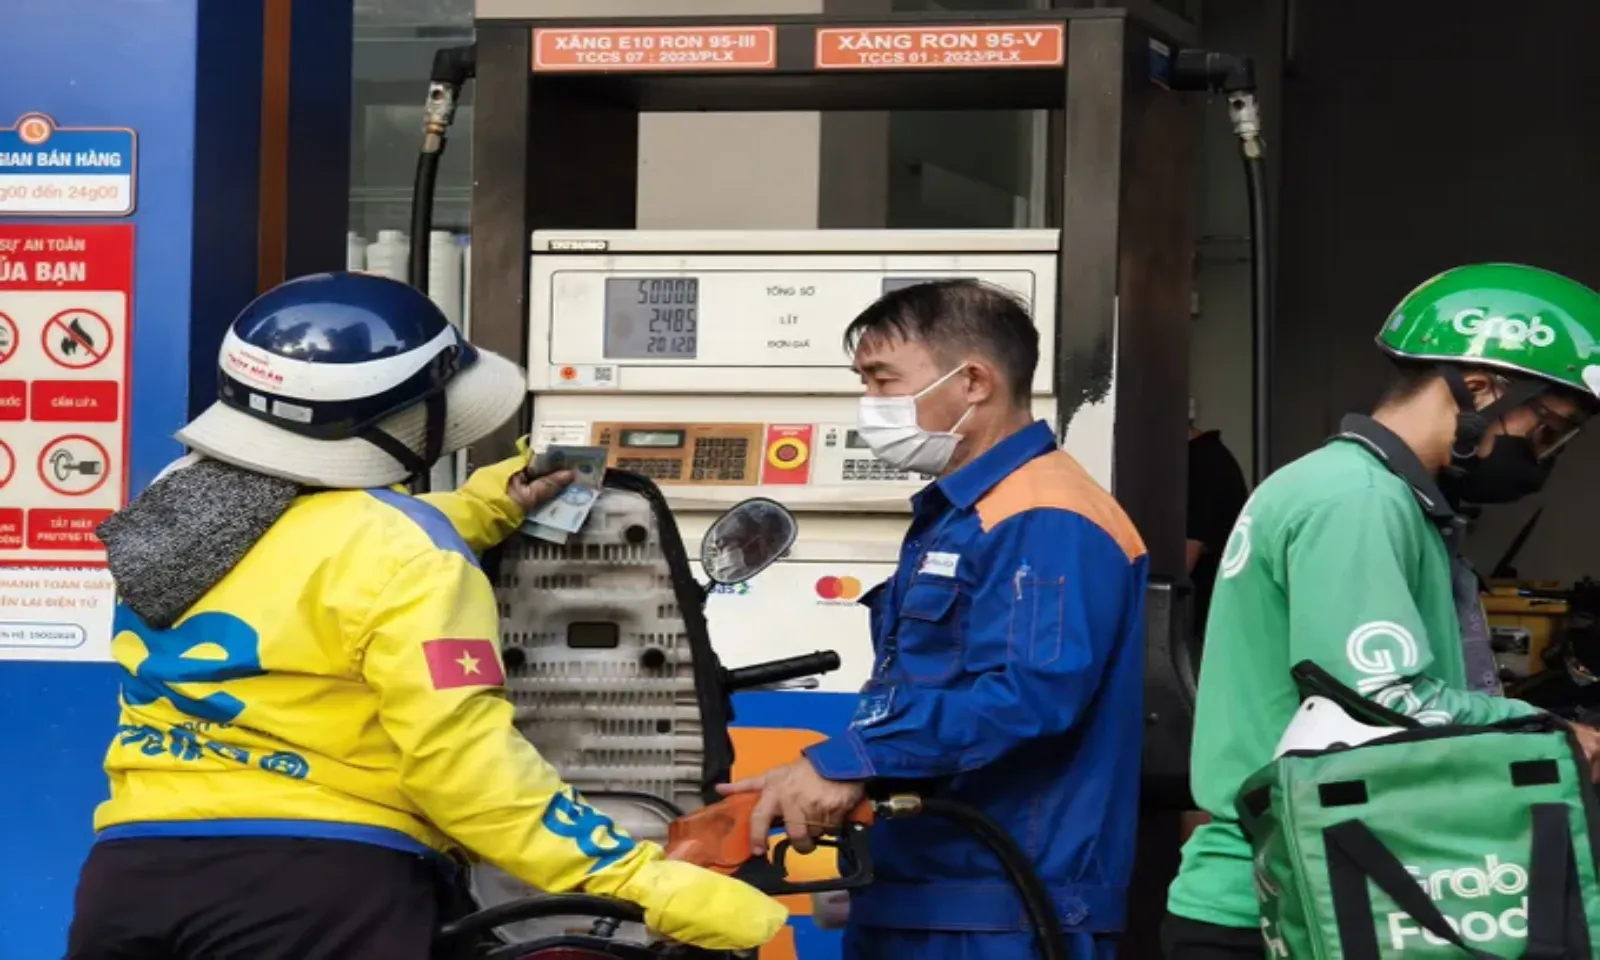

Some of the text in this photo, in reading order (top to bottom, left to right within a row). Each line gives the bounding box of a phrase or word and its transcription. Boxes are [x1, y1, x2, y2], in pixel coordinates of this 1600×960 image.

[555, 34, 755, 49] XĂNG E10 RON 95-III
[921, 33, 978, 48] RON
[986, 32, 1042, 47] 95-V
[576, 52, 620, 62] TCCS
[626, 52, 643, 62] 07
[660, 51, 734, 61] 2023/PLX
[859, 52, 904, 63] TCCS
[909, 52, 926, 62] 01
[944, 51, 1020, 62] 2023/PLX
[37, 149, 71, 166] BÁN
[75, 149, 121, 166] HÀNG
[33, 185, 61, 199] đến
[68, 186, 118, 201] 24g00
[23, 239, 43, 251] AN
[47, 236, 85, 251] TOÀN
[36, 261, 86, 286] BẠN
[637, 280, 697, 304] 50000
[1453, 308, 1555, 347] Grab
